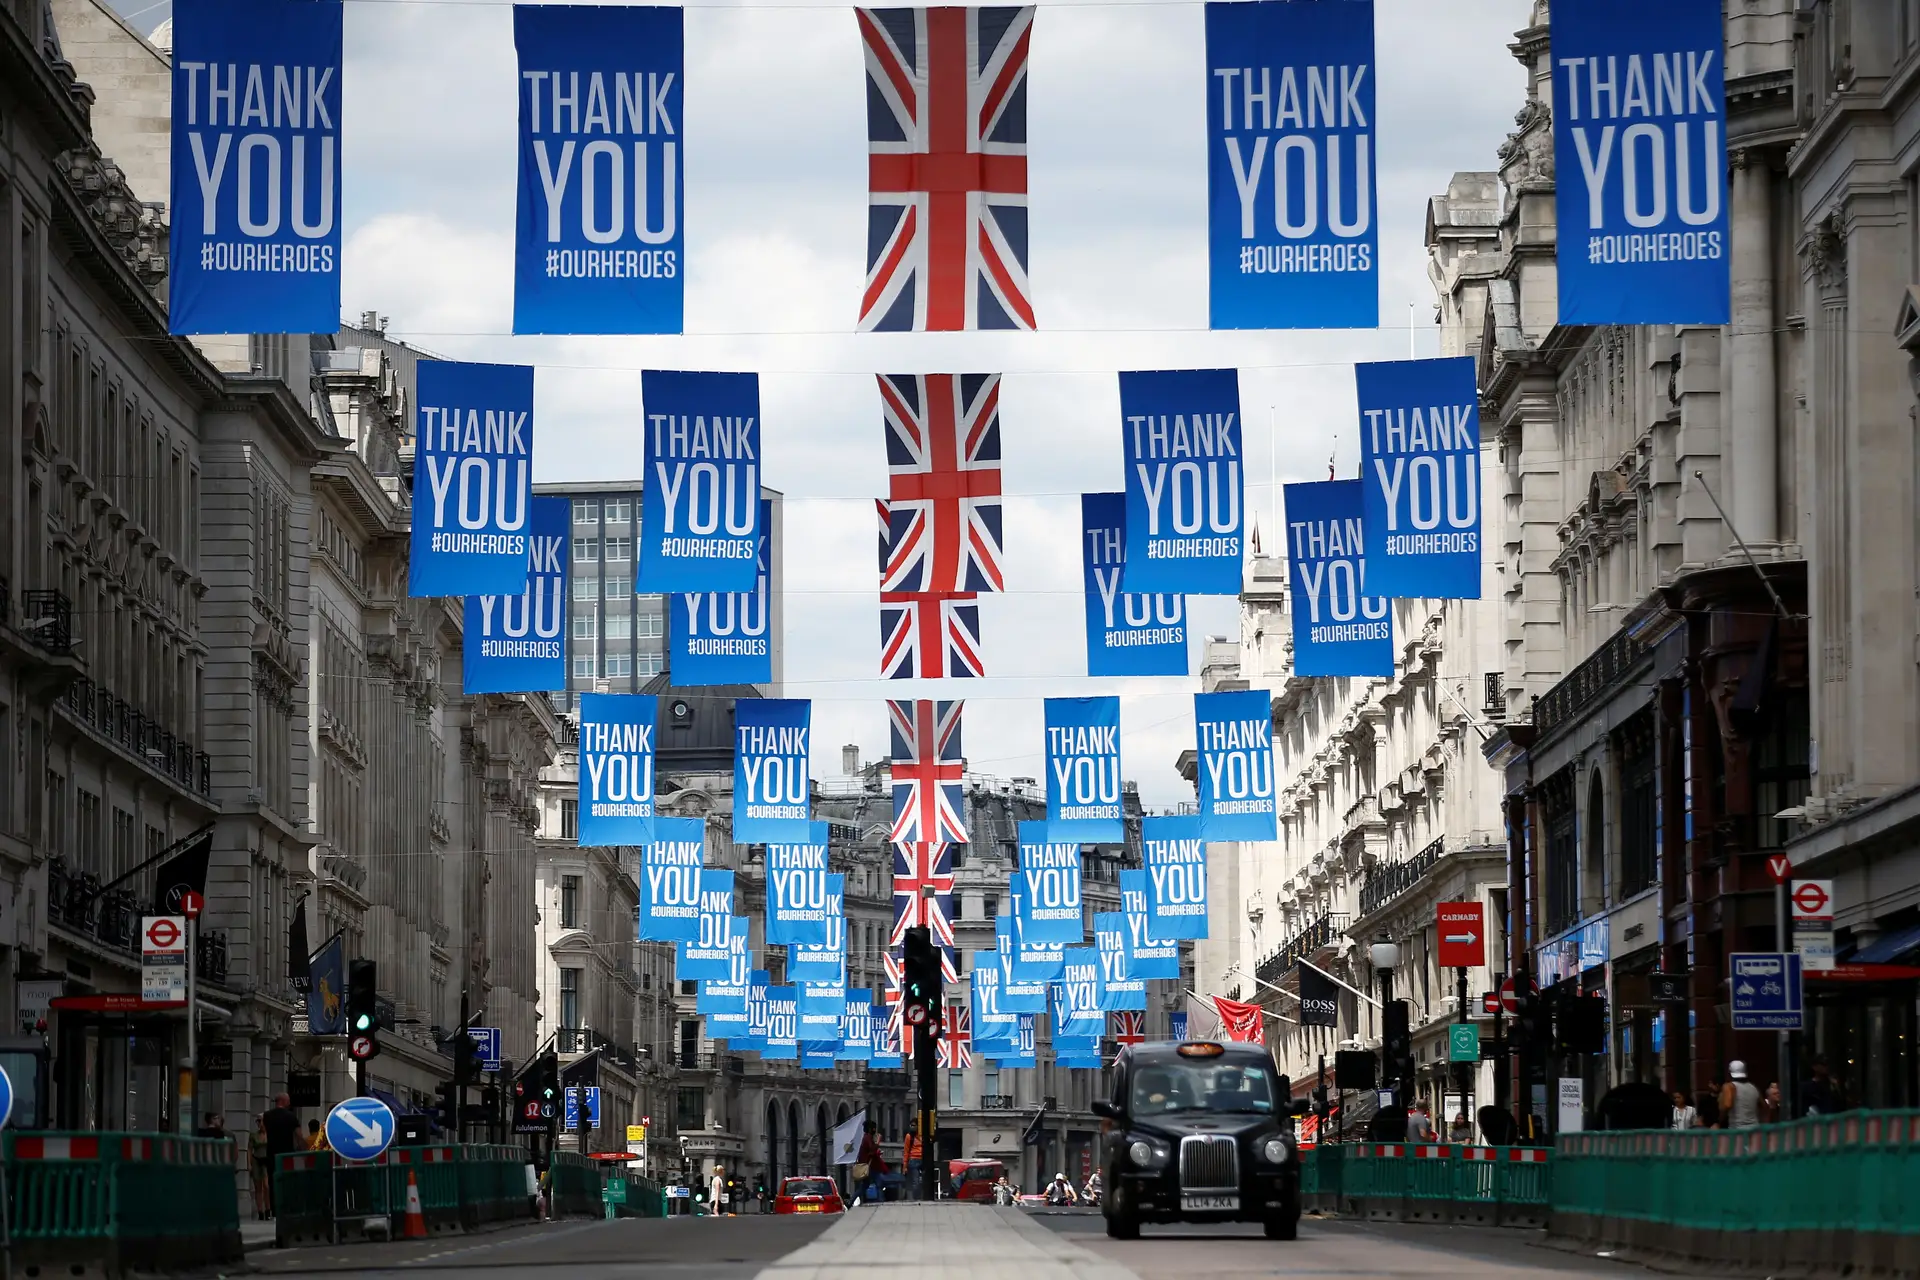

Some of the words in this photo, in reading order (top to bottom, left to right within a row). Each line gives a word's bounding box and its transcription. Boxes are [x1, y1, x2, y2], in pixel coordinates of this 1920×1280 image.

[180, 62, 334, 129] THANK
[1560, 50, 1716, 120] THANK
[524, 72, 676, 135] THANK
[1214, 65, 1368, 130] THANK
[189, 133, 334, 238] YOU
[1225, 134, 1368, 239] YOU
[1571, 120, 1718, 230] YOU
[534, 140, 676, 245] YOU
[201, 243, 333, 271] #OURHEROES
[1240, 244, 1370, 274] #OURHEROES
[1589, 231, 1721, 264] #OURHEROES
[547, 250, 676, 278] #OURHEROES
[421, 406, 527, 455] THANK
[648, 414, 755, 460] THANK
[1127, 412, 1236, 459] THANK
[1364, 404, 1473, 454] THANK
[426, 455, 526, 531] YOU
[655, 461, 755, 536] YOU
[1136, 460, 1238, 535] YOU
[1374, 454, 1476, 531] YOU
[431, 532, 524, 555] #OURHEROES
[661, 538, 753, 559] #OURHEROES
[1148, 536, 1238, 559] #OURHEROES
[1290, 518, 1364, 559] THAN
[1386, 532, 1477, 555] #OURHEROES
[1105, 627, 1182, 647] #OURHEROES
[1311, 621, 1388, 644] #OURHEROES
[482, 639, 559, 659] #OURHEROES
[688, 638, 766, 656] #OURHEROES
[583, 723, 652, 753] THANK
[739, 726, 806, 756] THANK
[1048, 725, 1117, 756] THANK
[1199, 719, 1269, 751] THANK
[586, 754, 651, 802] YOU
[742, 756, 806, 804] YOU
[1053, 756, 1118, 804] YOU
[1205, 750, 1271, 799] YOU
[591, 803, 650, 817] #OURHEROES
[747, 805, 806, 819] #OURHEROES
[1060, 805, 1119, 820] #OURHEROES
[1213, 799, 1272, 815] #OURHEROES
[769, 844, 825, 869] THANK
[1022, 843, 1078, 868] THANK
[1146, 839, 1203, 863] THANK
[1771, 858, 1787, 877] V
[647, 865, 701, 905] YOU
[772, 869, 825, 909] YOU
[1026, 868, 1079, 908] YOU
[1150, 864, 1204, 904] YOU
[187, 895, 197, 912] L
[651, 906, 699, 919] #OURHEROES
[700, 892, 730, 914] ANK
[1032, 908, 1080, 920] #OURHEROES
[1157, 904, 1205, 916] #OURHEROES
[777, 910, 825, 922] #OURHEROES
[1097, 930, 1123, 952] THA
[686, 949, 729, 960] #OURHEROES
[797, 952, 840, 963] #OURHEROES
[1020, 951, 1063, 962] #OURHEROES
[1133, 947, 1176, 959] #OURHEROES
[976, 968, 998, 985] THA
[1065, 965, 1097, 982] THAN
[1101, 952, 1125, 982] YO
[1105, 981, 1144, 992] #OURHEROES
[768, 1000, 796, 1014] HANK
[1303, 999, 1335, 1011] BOSS
[1737, 998, 1752, 1008] taxi
[767, 1015, 796, 1038] YOU
[871, 1017, 888, 1030] THA
[1762, 1015, 1799, 1027] Midnight
[482, 1062, 498, 1070] dnight
[516, 1124, 548, 1132] lululemon
[642, 1117, 650, 1125] M
[1213, 1197, 1232, 1208] ZKA
